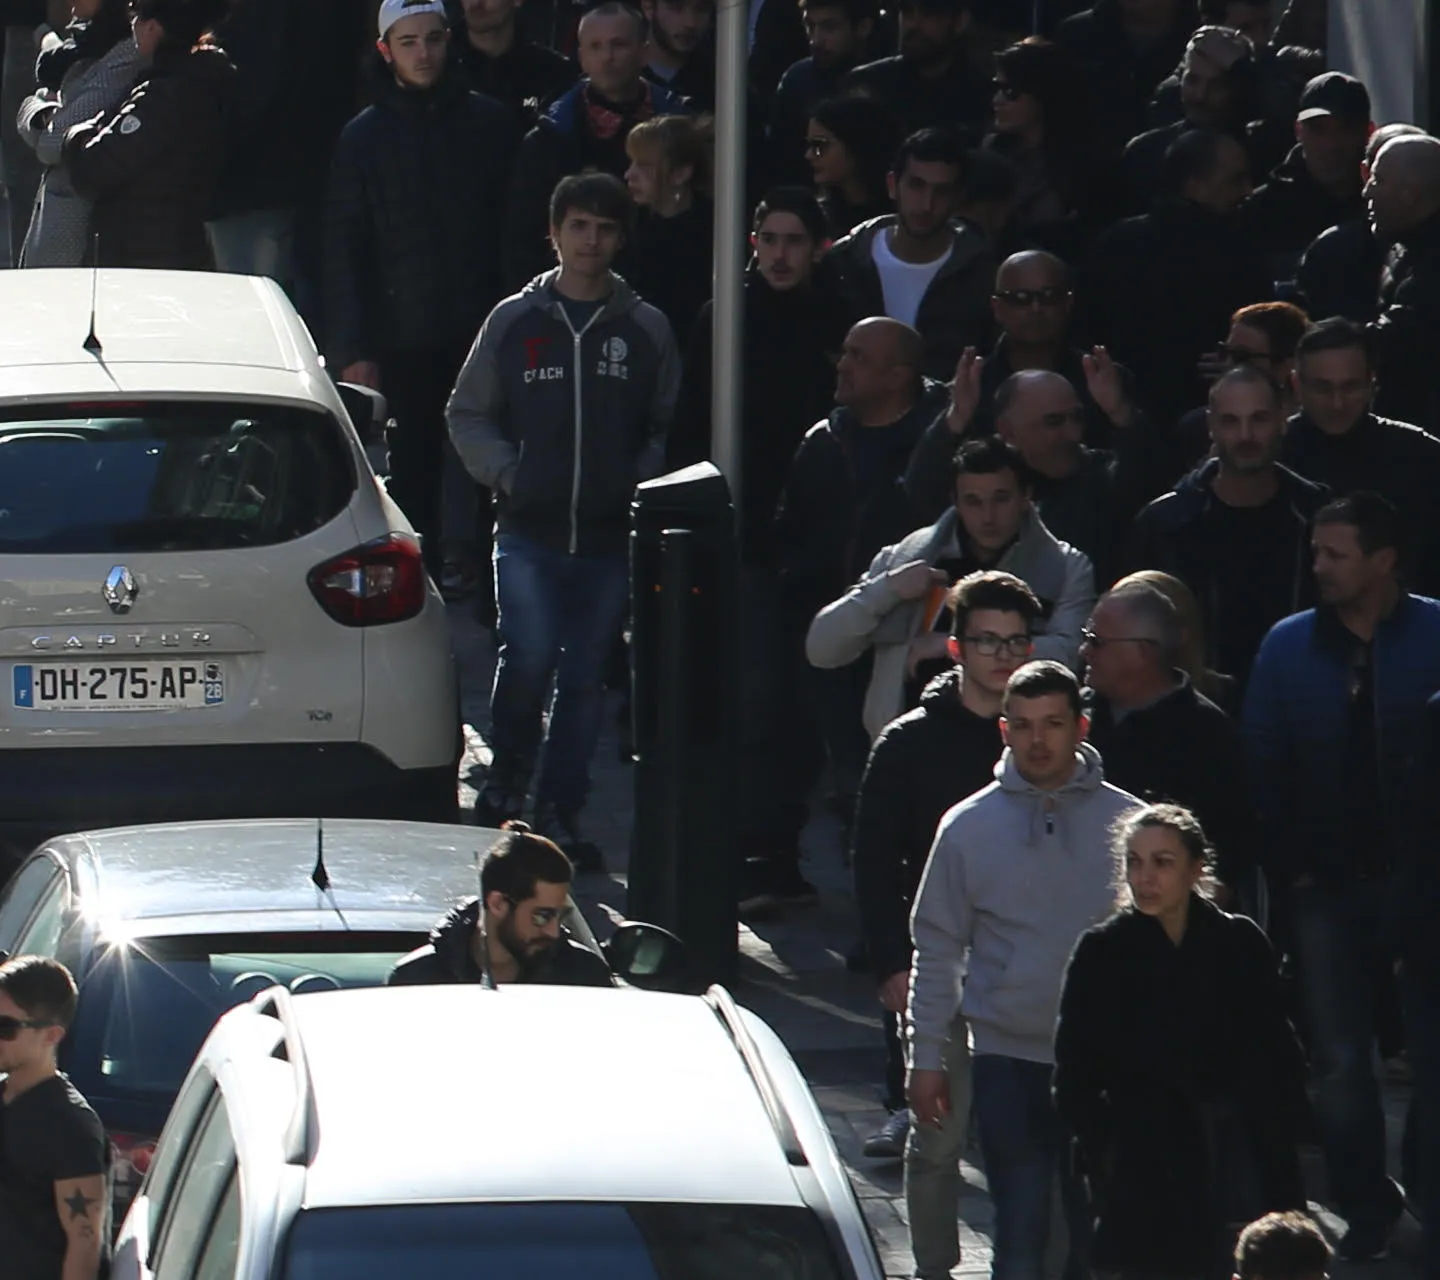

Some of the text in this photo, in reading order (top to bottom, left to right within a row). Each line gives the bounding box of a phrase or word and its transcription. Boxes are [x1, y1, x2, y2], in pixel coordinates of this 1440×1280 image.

[31, 632, 212, 651] CAPTUR
[40, 666, 198, 701] DH-275-AP
[205, 681, 223, 700] 2B
